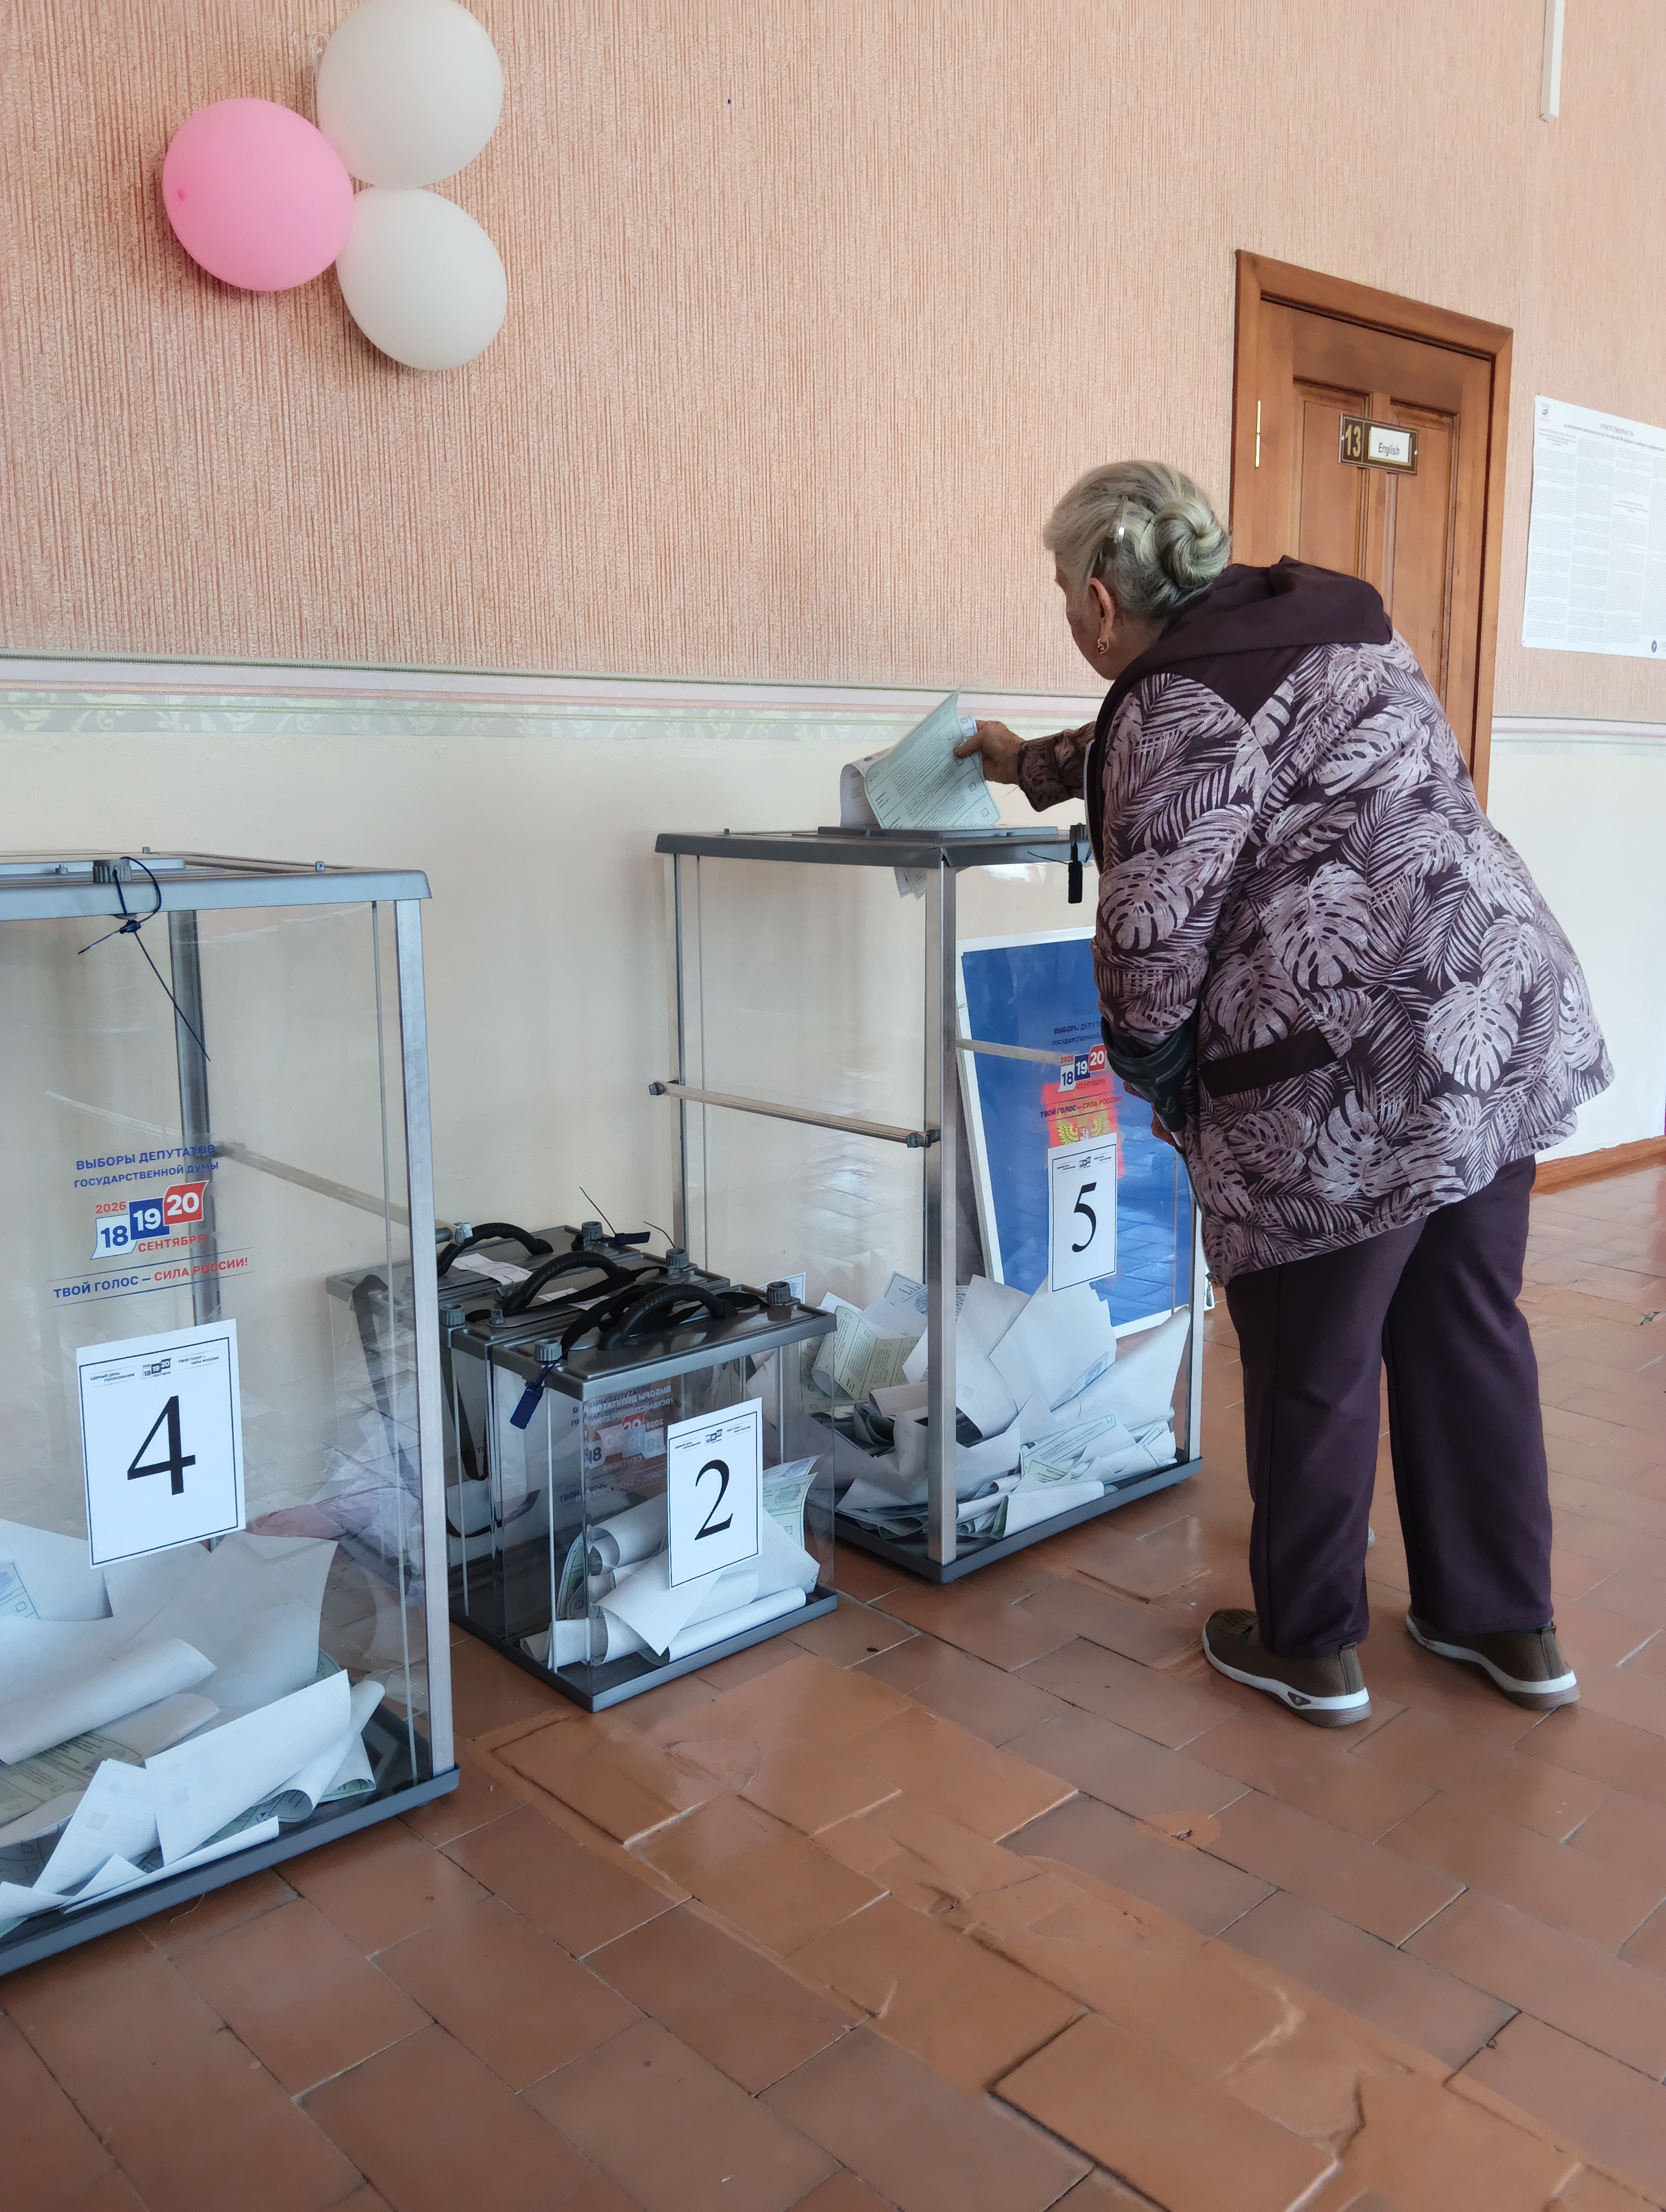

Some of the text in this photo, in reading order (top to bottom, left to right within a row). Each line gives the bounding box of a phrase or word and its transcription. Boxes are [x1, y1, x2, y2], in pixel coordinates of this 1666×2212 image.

[1345, 424, 1361, 458] 13
[1378, 442, 1400, 456] English
[1060, 1055, 1074, 1064] 2026
[1061, 1050, 1105, 1086] 18 19 20
[1077, 1078, 1106, 1090] СЕНТЯБРЯ
[1040, 1107, 1056, 1118] ТВОЙ
[1058, 1104, 1077, 1114] ГОЛОС
[1082, 1101, 1098, 1109] СИЛА
[76, 1144, 215, 1171] ВЫБОРЫ ДЕПУТАТОВ
[74, 1161, 219, 1188] ГОСУДАРСТВЕННОЙ ДУМЫ
[95, 1201, 126, 1214] 2026
[100, 1192, 200, 1248] 18 19 20
[1072, 1181, 1097, 1253] 5
[138, 1233, 207, 1252] СЕНТЯБРЯ
[53, 1281, 91, 1299] ТВОЙ
[94, 1276, 139, 1293] ГОЛОС
[154, 1267, 189, 1282] СИЛА
[193, 1257, 248, 1275] РОССИИ!
[127, 1395, 196, 1496] 4
[694, 1459, 734, 1541] 2
